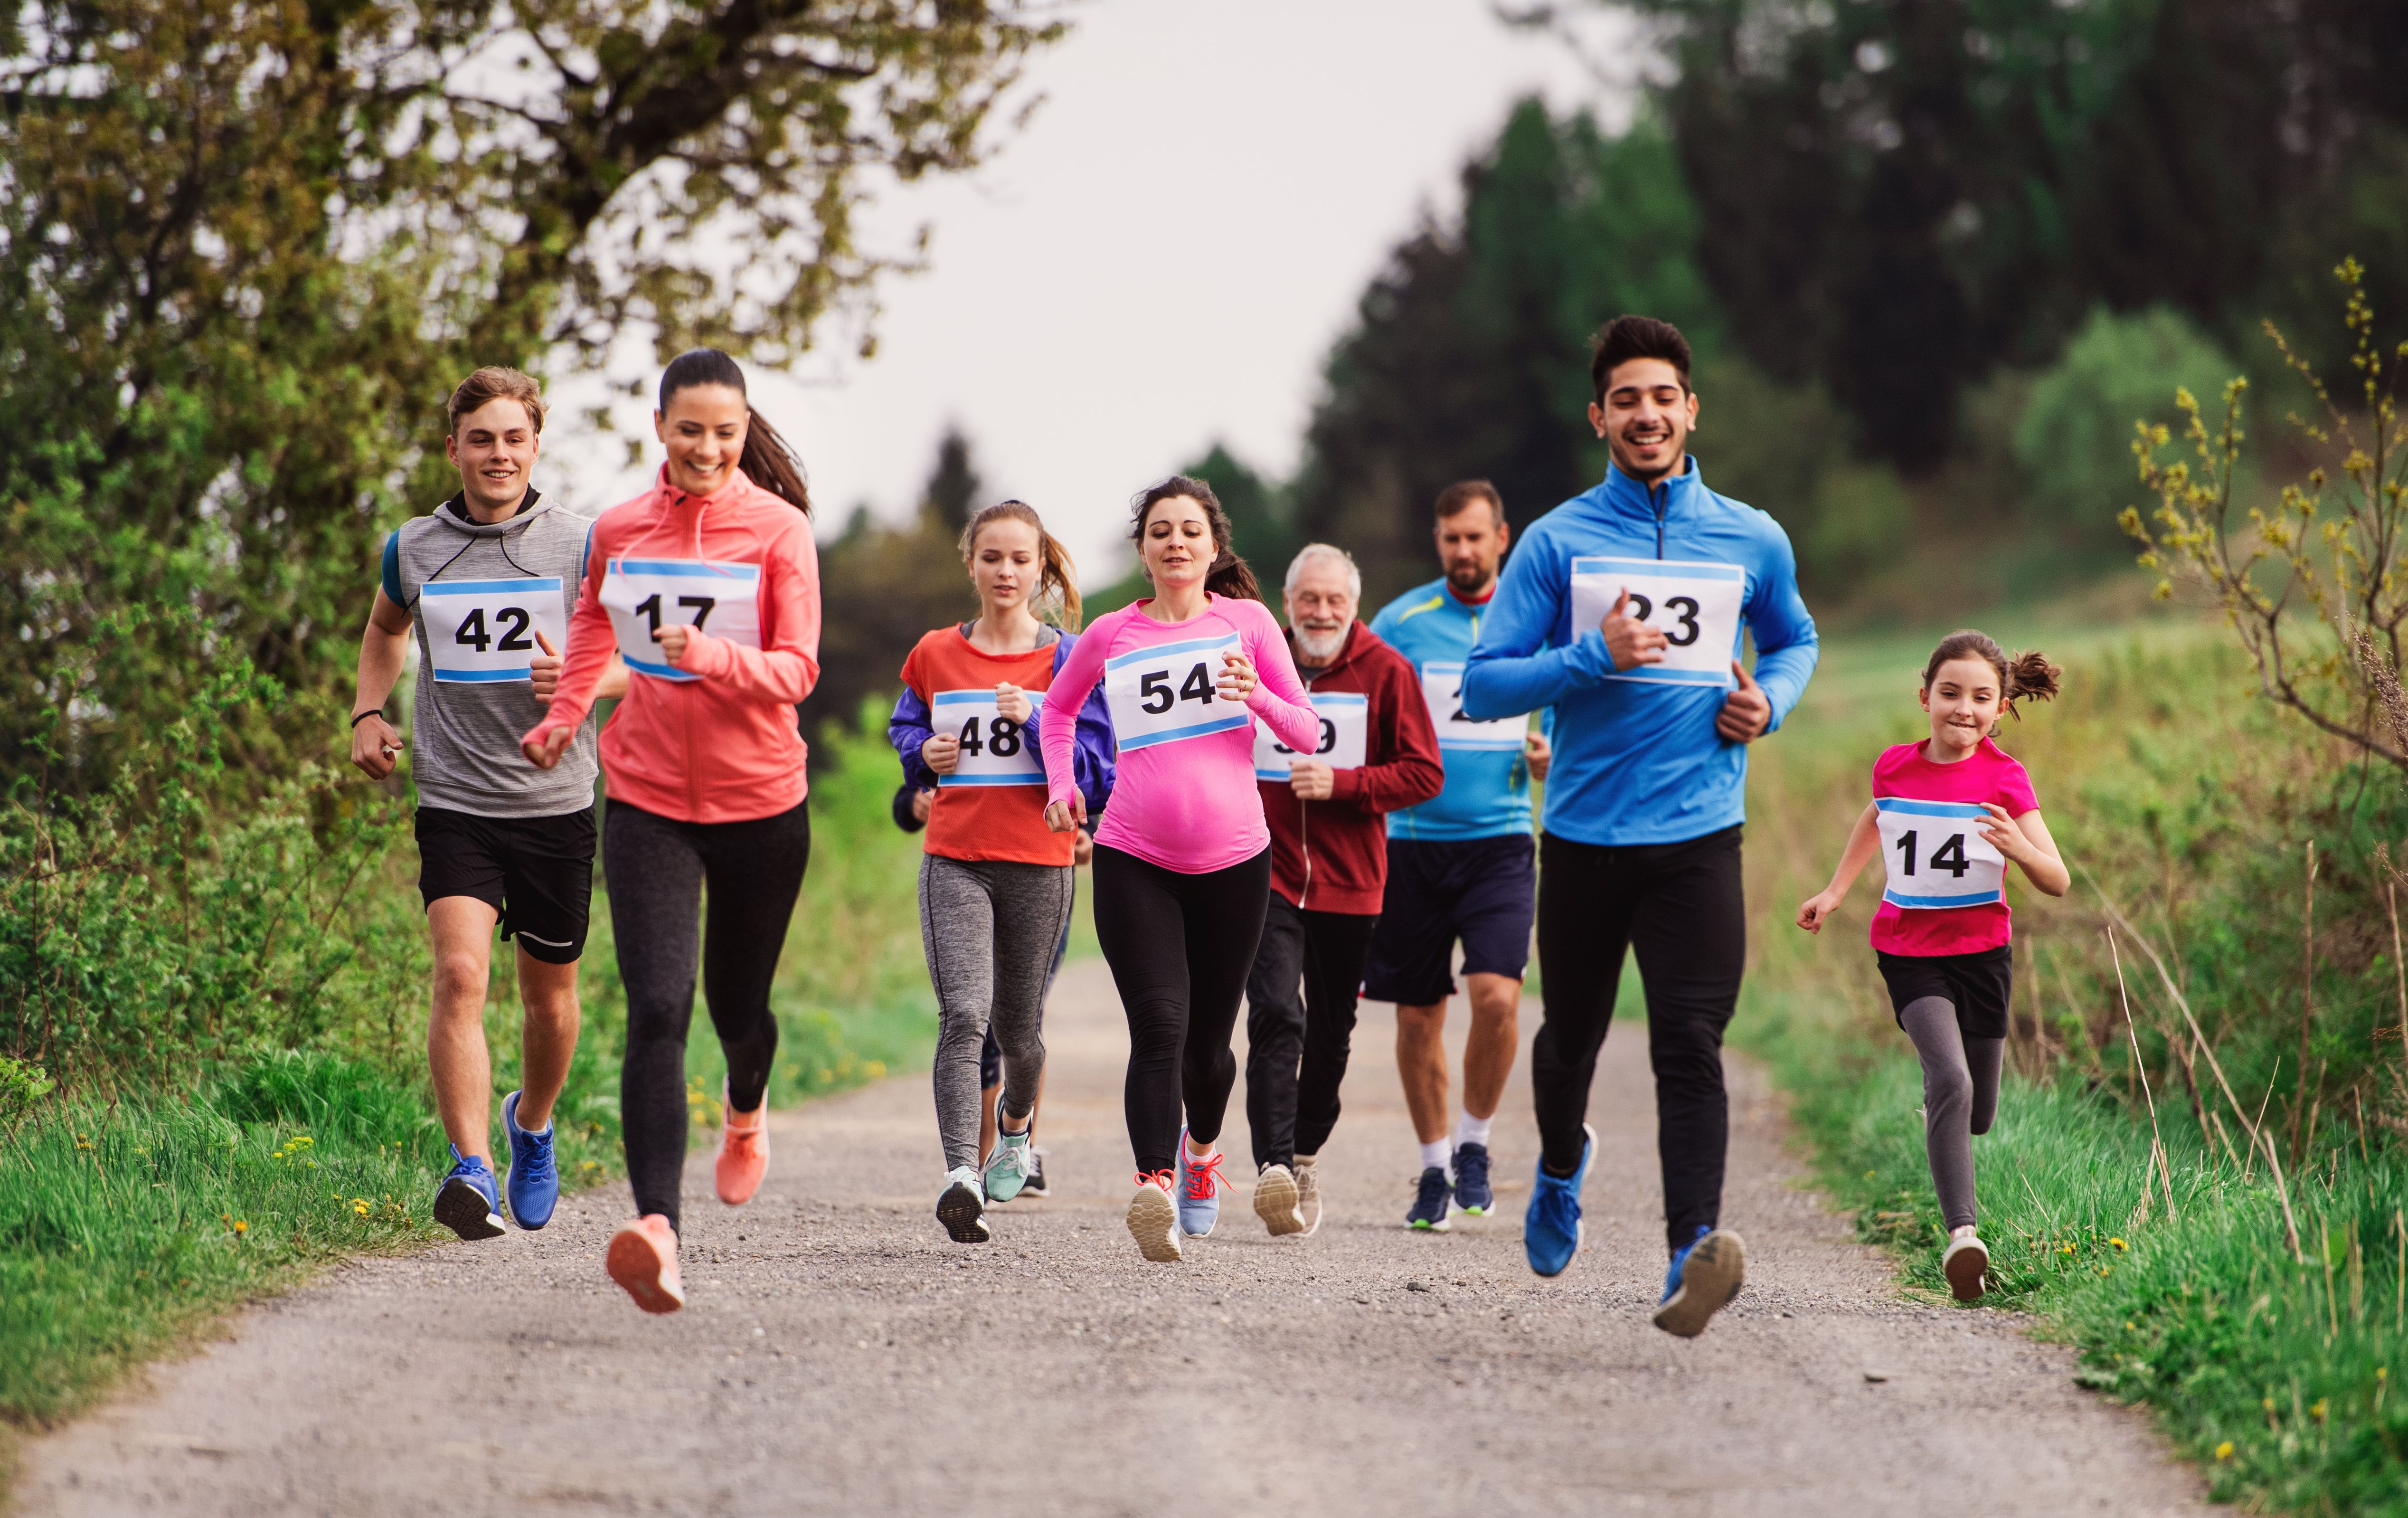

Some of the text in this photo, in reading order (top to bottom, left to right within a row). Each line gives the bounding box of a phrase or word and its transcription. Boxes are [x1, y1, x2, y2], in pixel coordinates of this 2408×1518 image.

[454, 607, 533, 653] 42
[636, 594, 715, 643] 17
[1141, 662, 1217, 715] 54
[959, 716, 1020, 757] 48
[1273, 718, 1337, 754] 9
[1897, 829, 1970, 878] 14
